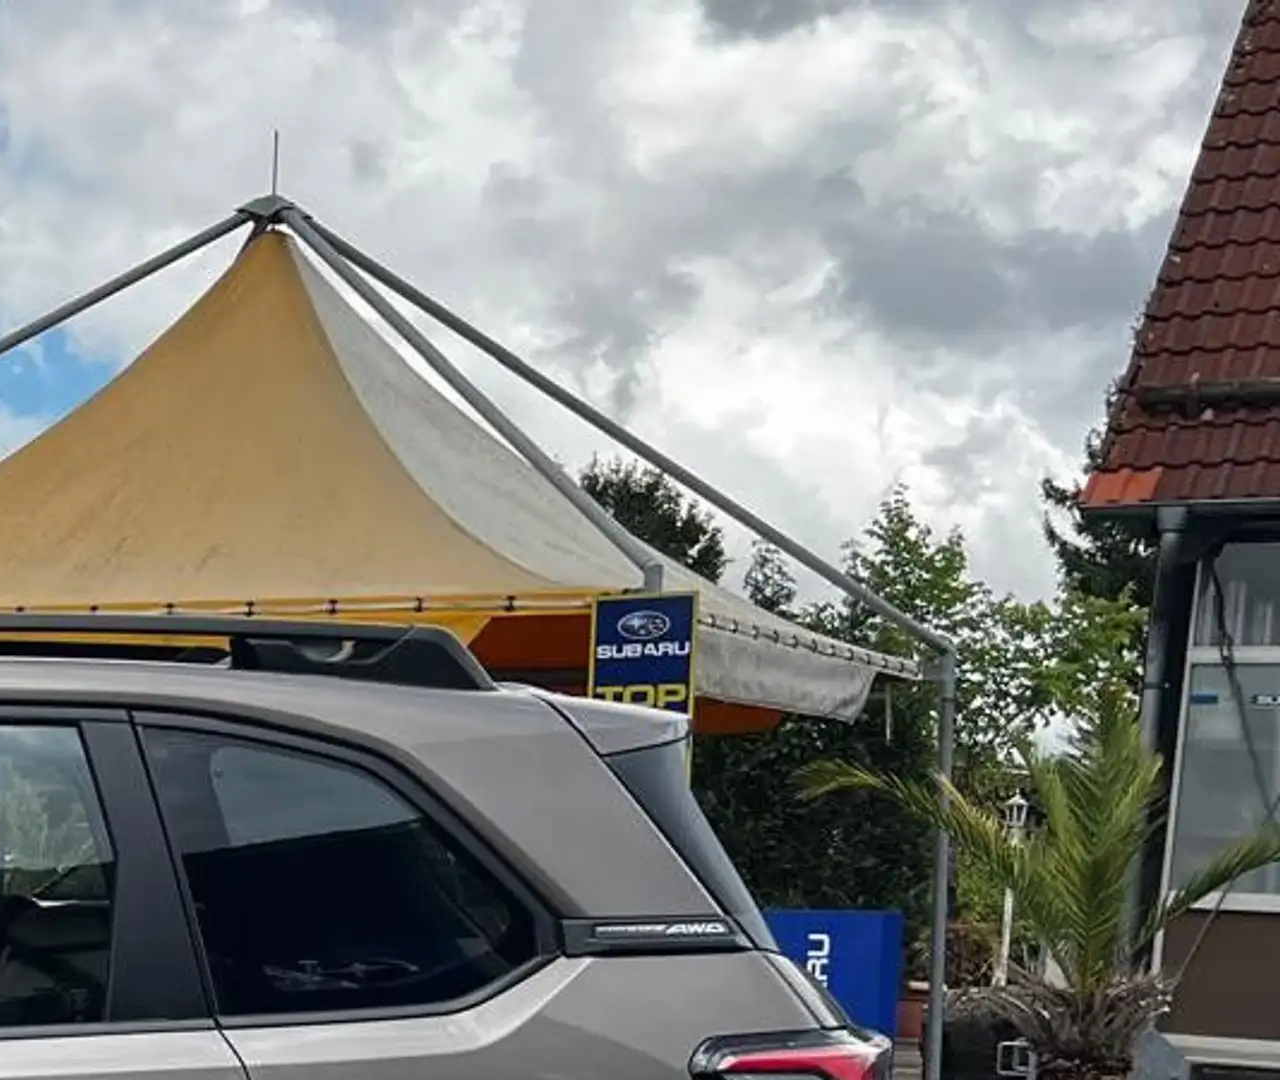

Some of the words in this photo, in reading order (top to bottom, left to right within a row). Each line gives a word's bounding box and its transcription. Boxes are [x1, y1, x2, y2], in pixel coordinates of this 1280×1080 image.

[596, 641, 691, 659] SUBARU
[595, 684, 687, 708] TOP
[807, 933, 830, 988] RU
